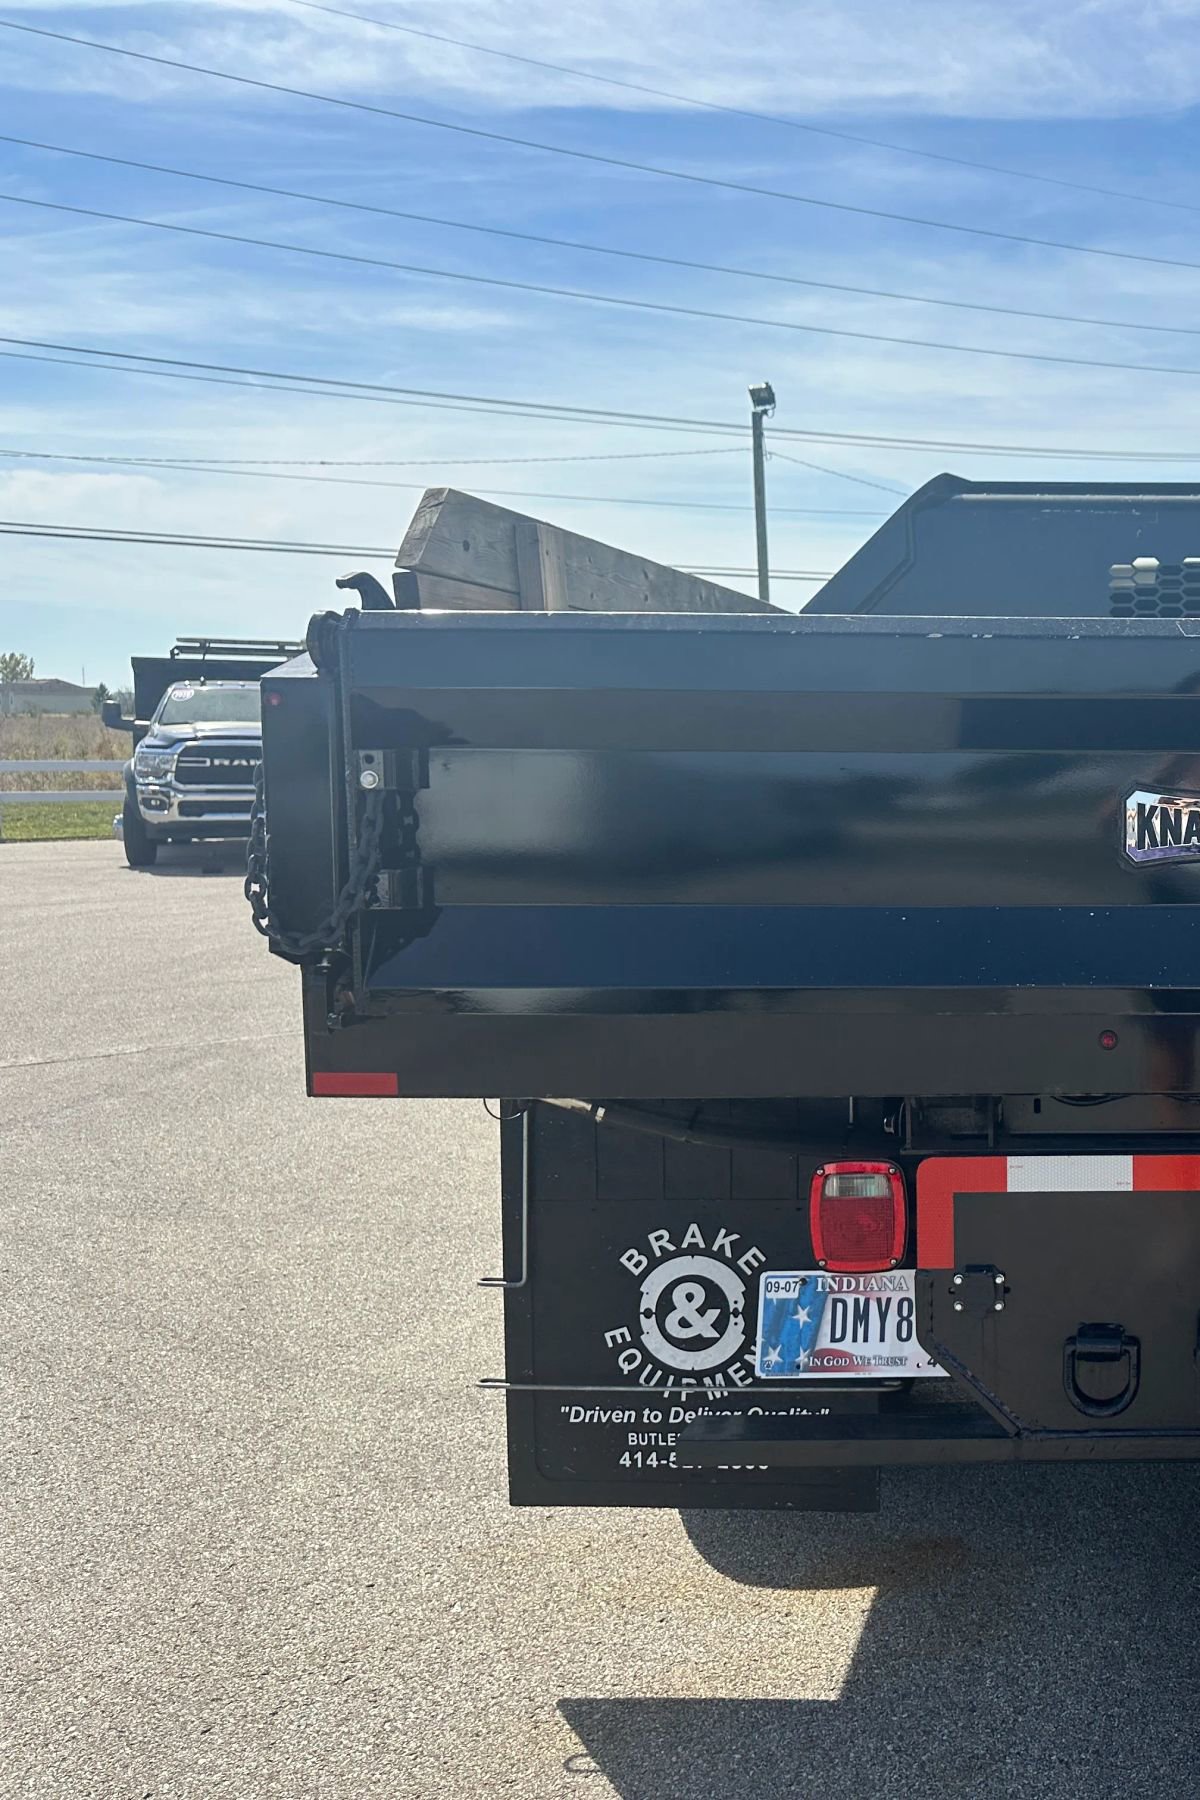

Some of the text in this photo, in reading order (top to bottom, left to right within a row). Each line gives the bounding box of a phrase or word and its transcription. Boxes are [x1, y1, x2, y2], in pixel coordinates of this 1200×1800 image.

[619, 1223, 767, 1276] BRAKE
[766, 1281, 798, 1293] 09-07
[816, 1276, 909, 1292] INDIANA
[664, 1282, 721, 1339] &
[830, 1297, 914, 1343] DMY8
[604, 1326, 757, 1401] EQUIPME
[823, 1355, 850, 1367] GOD
[560, 1406, 635, 1423] "Driven
[642, 1407, 662, 1423] to
[628, 1432, 681, 1446] BUTLE
